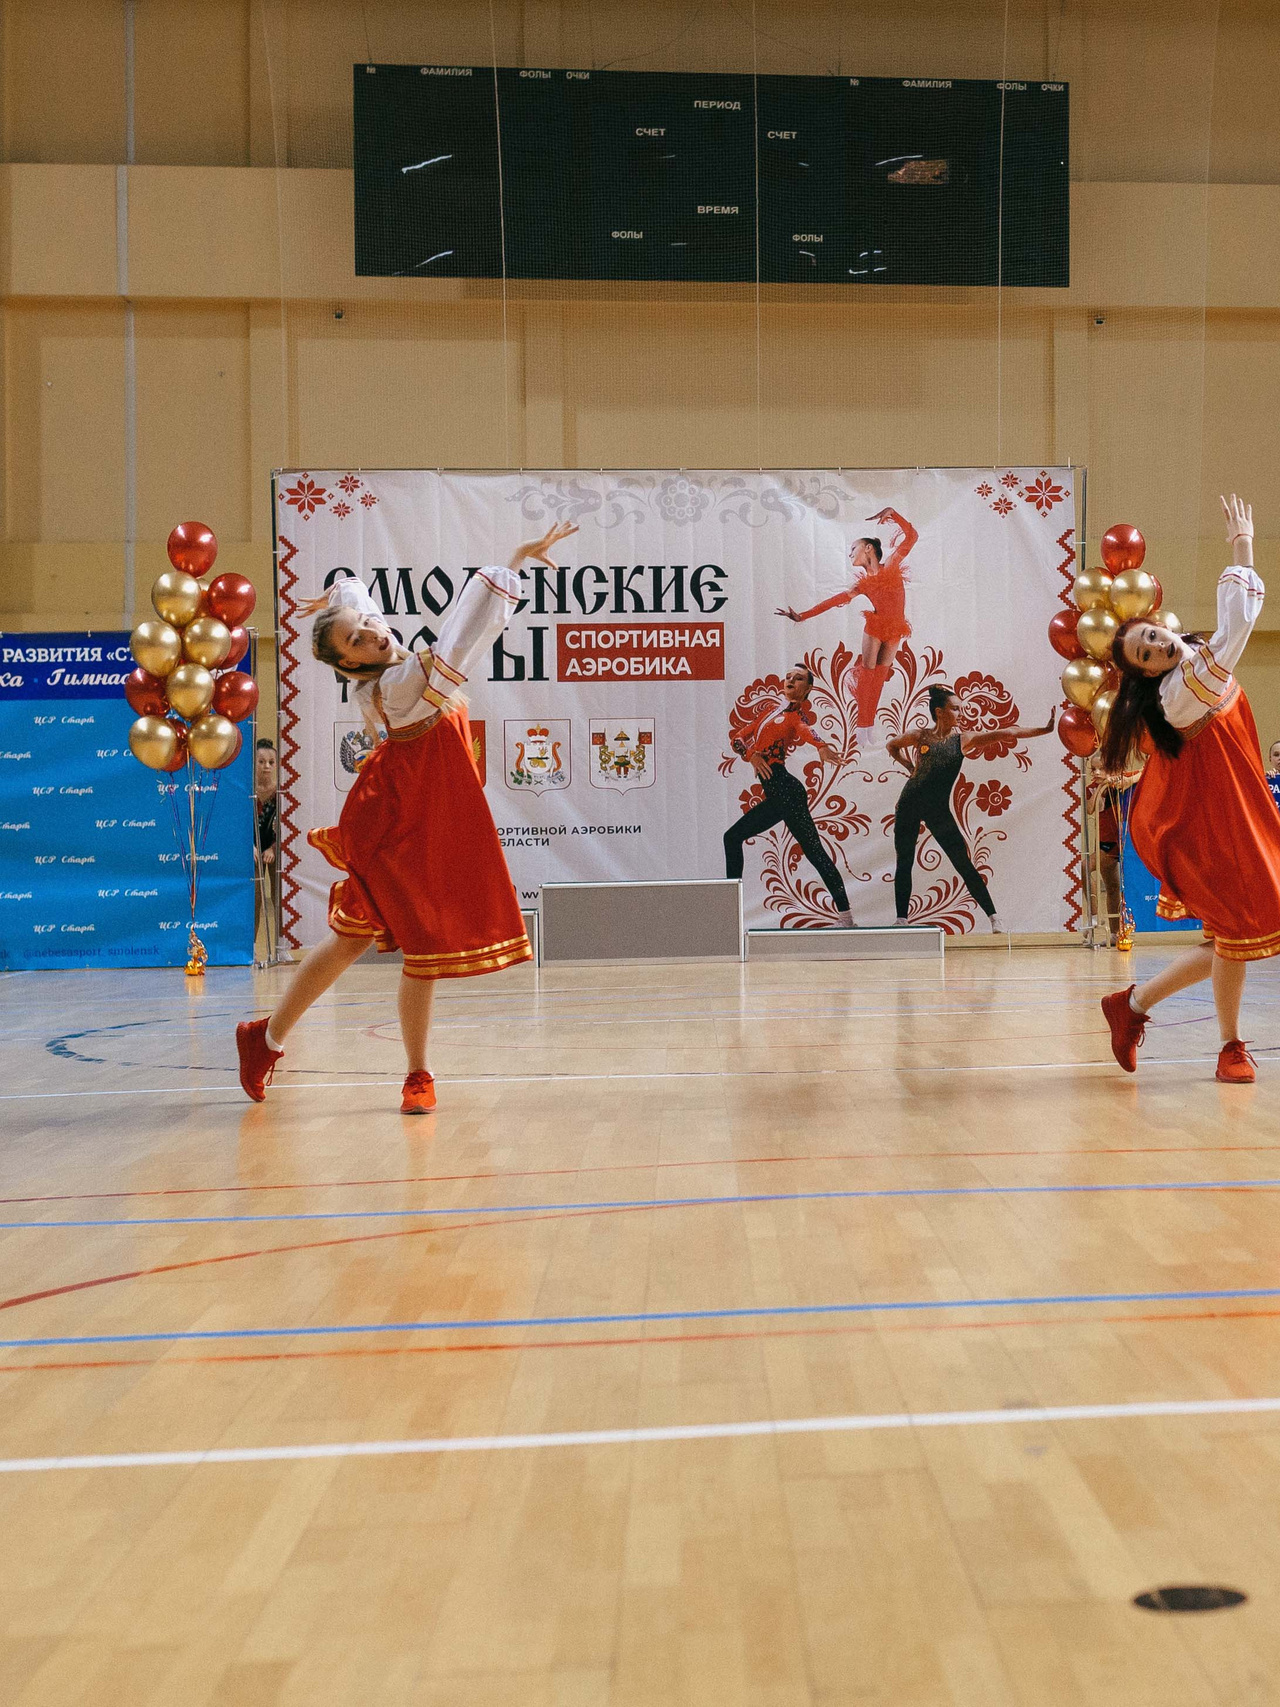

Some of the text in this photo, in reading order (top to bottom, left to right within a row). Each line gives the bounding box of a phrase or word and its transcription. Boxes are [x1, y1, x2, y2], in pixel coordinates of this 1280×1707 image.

[420, 67, 473, 77] ФАМИЛИЯ
[519, 69, 552, 80] ФОЛЫ
[566, 71, 590, 80] ОЧКИ
[902, 80, 952, 89] ФАМИЛИЯ
[997, 82, 1027, 92] ФОЛЫ
[1041, 83, 1065, 92] ОЧКИ
[694, 100, 742, 111] ПЕРИОД
[635, 127, 666, 137] СЧЕТ
[767, 130, 797, 140] СЧЕТ
[697, 205, 739, 215] ВРЕМЯ
[611, 230, 643, 239] ФОЛЫ
[792, 234, 823, 243] ФОЛЫ
[324, 564, 729, 615] МОНСКИЕ
[565, 628, 720, 650] СПОРТИВНАЯ
[2, 647, 103, 663] РАЗВИТИЯ
[565, 656, 692, 677] АЭРОБИКА
[46, 668, 131, 686] Гимнас
[61, 716, 95, 725] Старт
[60, 786, 93, 796] Старт
[122, 819, 156, 829] Старт
[497, 825, 642, 836] ОРТИВНОЙ АЭРОБИКИ
[501, 838, 550, 847] БЛАСТИ
[61, 855, 96, 865] Старт
[124, 888, 158, 898] Старт
[60, 924, 95, 934] Старт
